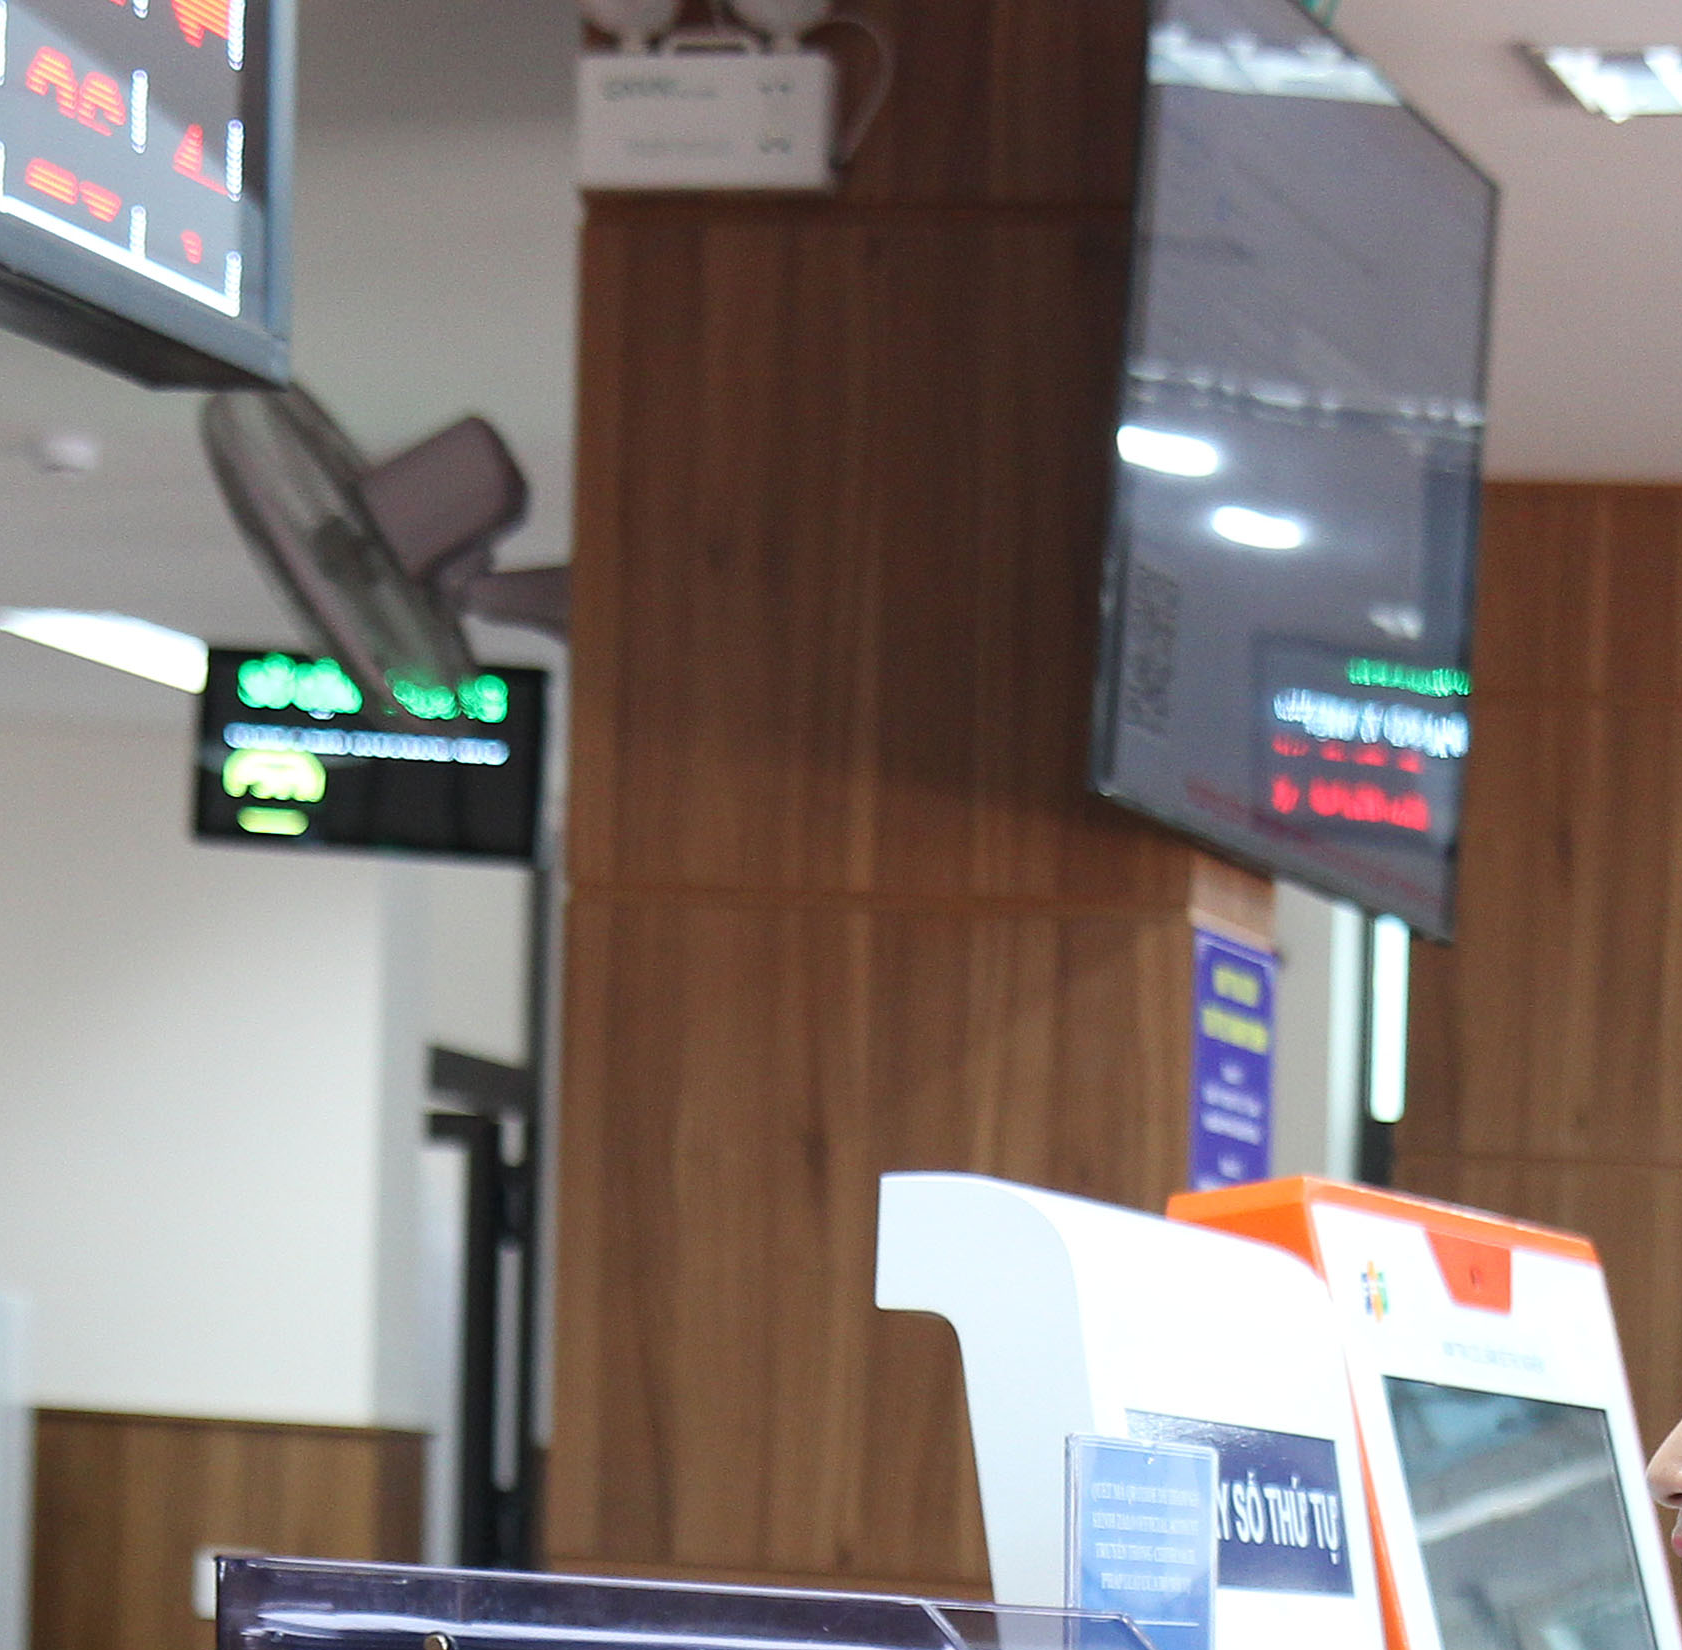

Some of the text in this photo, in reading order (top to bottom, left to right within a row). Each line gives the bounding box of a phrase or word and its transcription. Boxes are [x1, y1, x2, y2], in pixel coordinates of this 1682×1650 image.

[1231, 1469, 1265, 1545] SỐ
[1263, 1475, 1310, 1549] THỨ
[1308, 1491, 1340, 1566] TỰ
